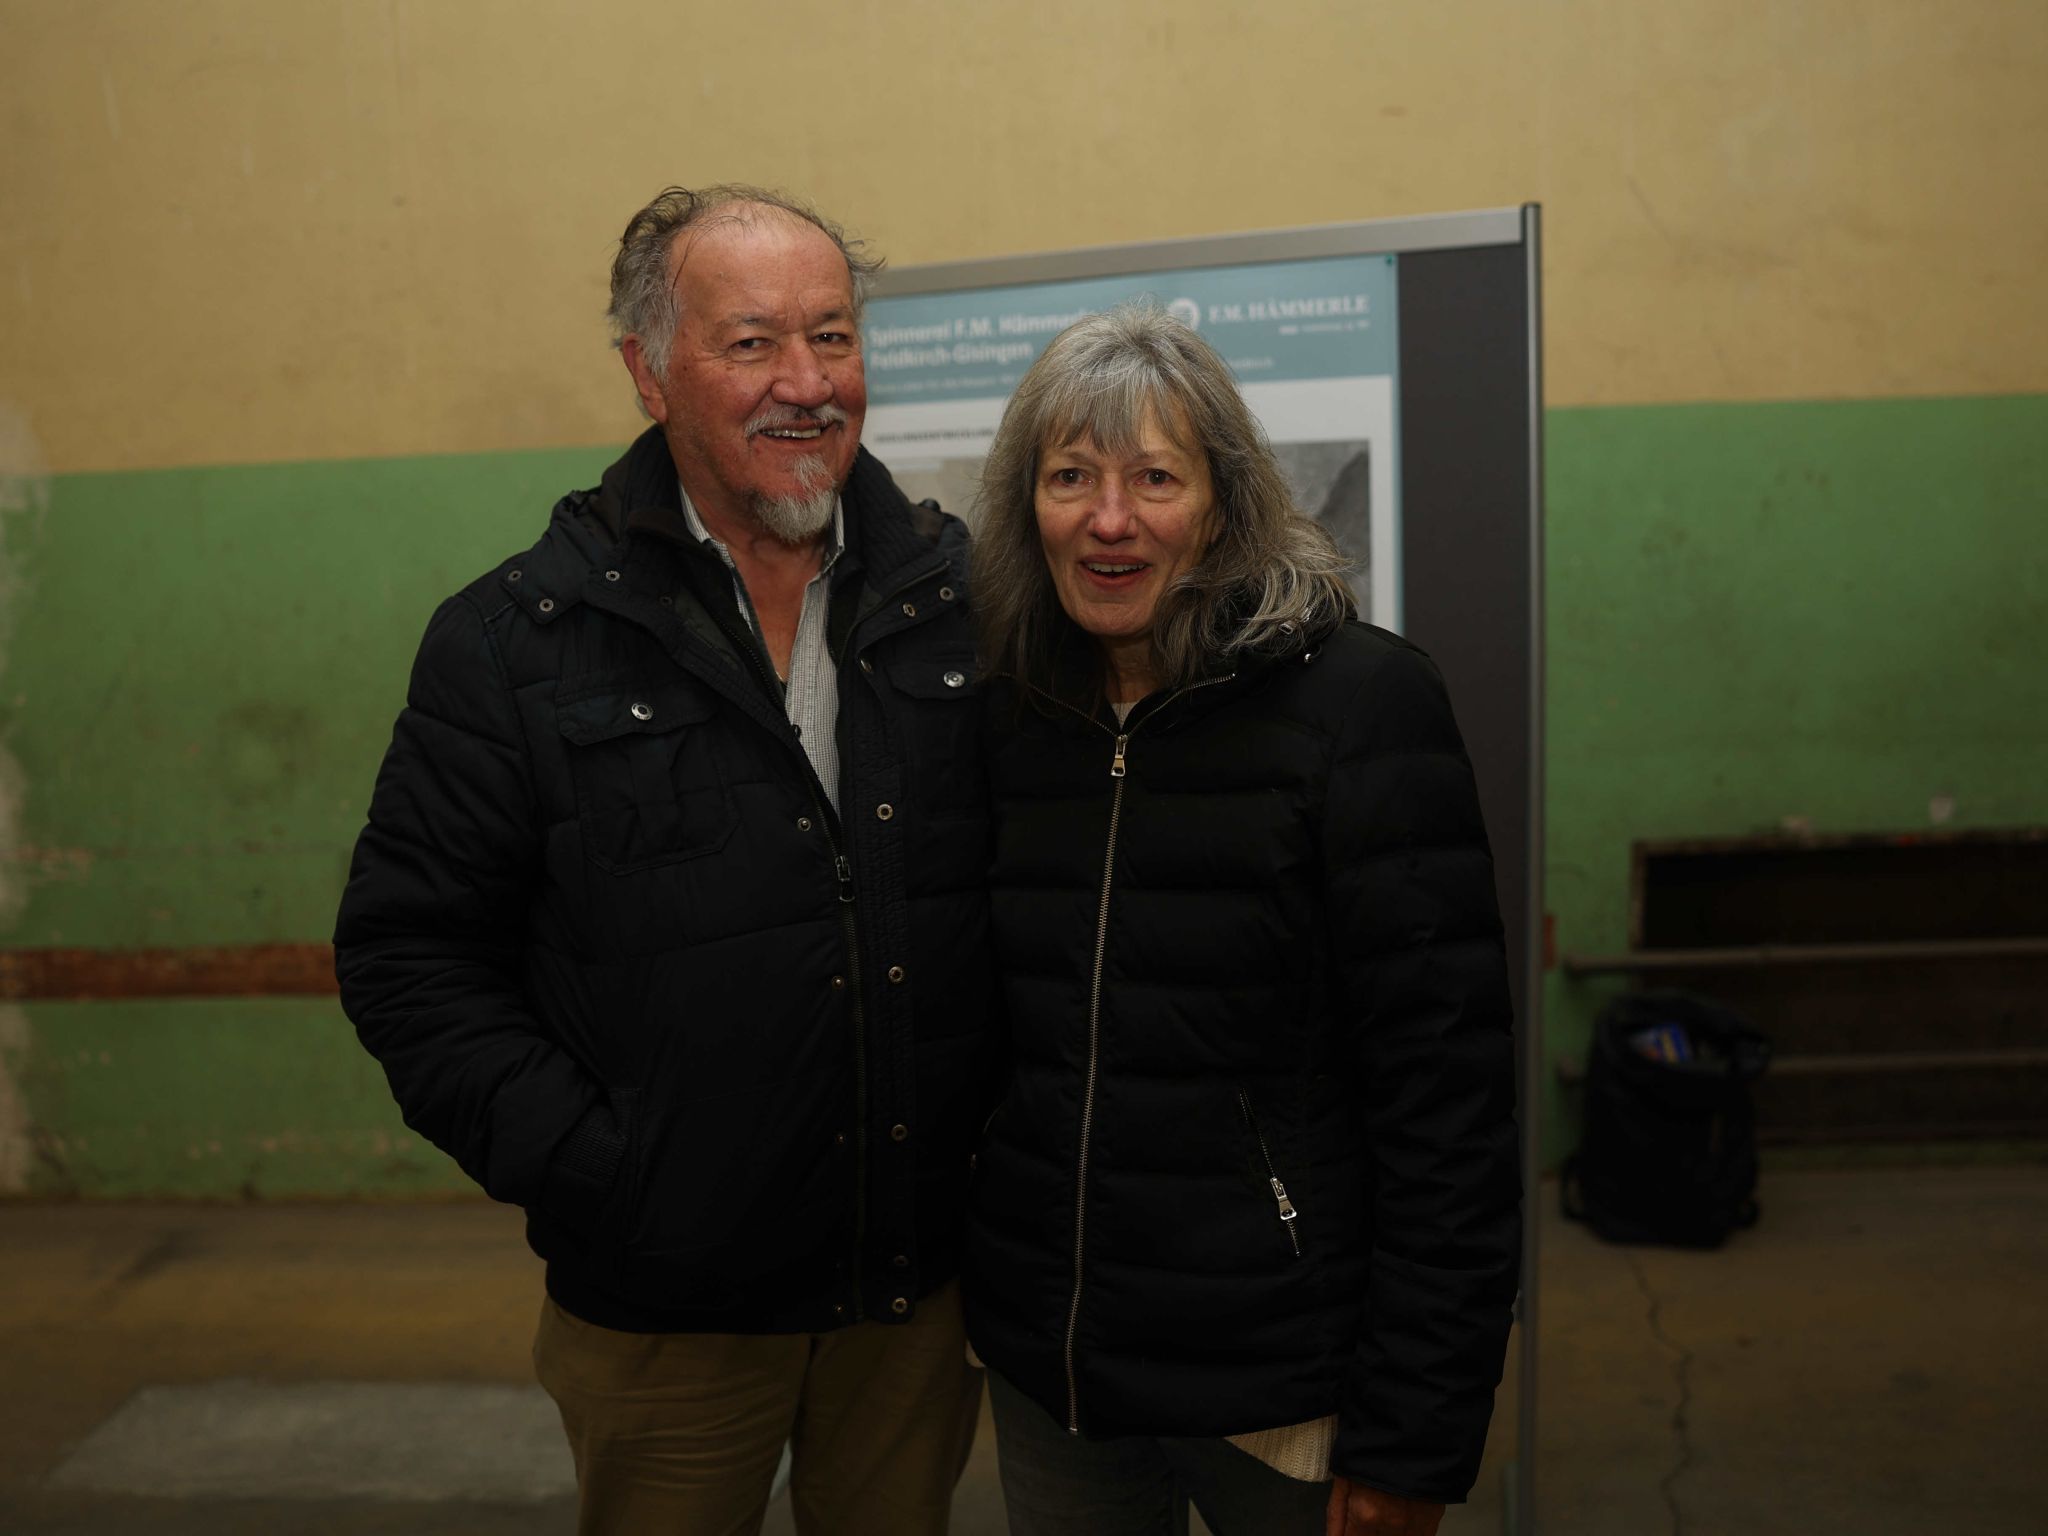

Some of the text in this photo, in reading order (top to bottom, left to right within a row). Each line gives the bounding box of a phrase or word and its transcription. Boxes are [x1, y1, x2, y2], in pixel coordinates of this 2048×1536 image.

[1208, 296, 1369, 324] F.M. HÄMMERLE
[869, 321, 949, 347] Spinnerei
[954, 318, 994, 337] F.M.
